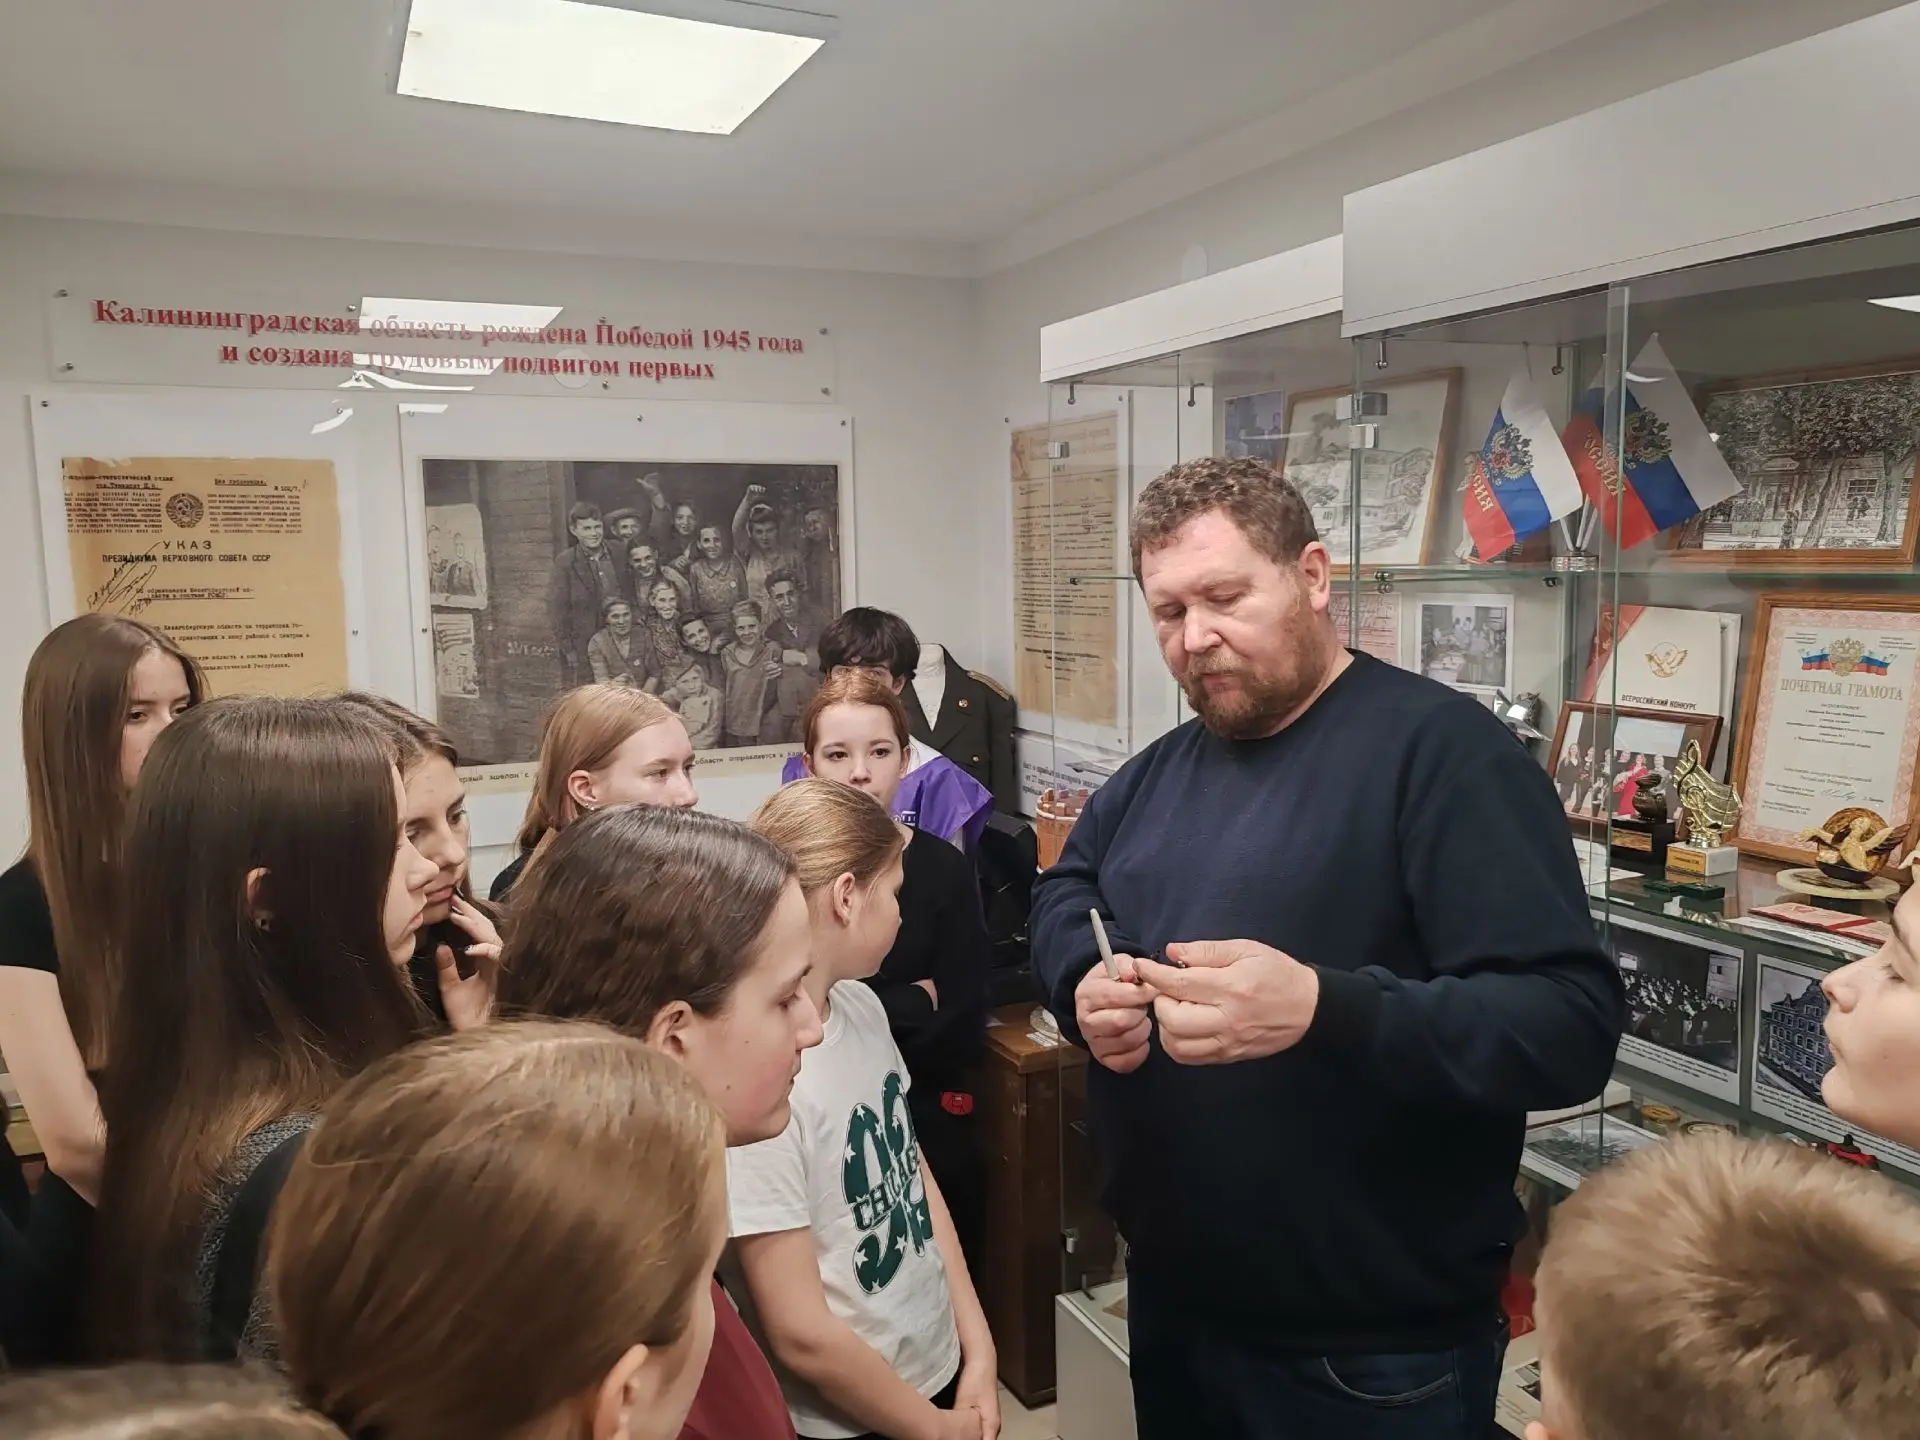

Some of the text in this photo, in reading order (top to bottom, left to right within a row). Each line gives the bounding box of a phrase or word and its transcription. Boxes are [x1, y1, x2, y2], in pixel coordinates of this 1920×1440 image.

[94, 299, 805, 354] Калининградская область рождена Победой 1945 года
[219, 344, 715, 383] и создана трудовым подвигом первых
[102, 553, 271, 563] ПРЕЗИДИУМА ВЕРХОВНОГО СОВЕТА СССР
[1669, 699, 1697, 711] КОНКУРС
[1780, 678, 1904, 701] ПОЧЕТНАЯ ГРАМОТА
[850, 1138, 920, 1231] CHICAG
